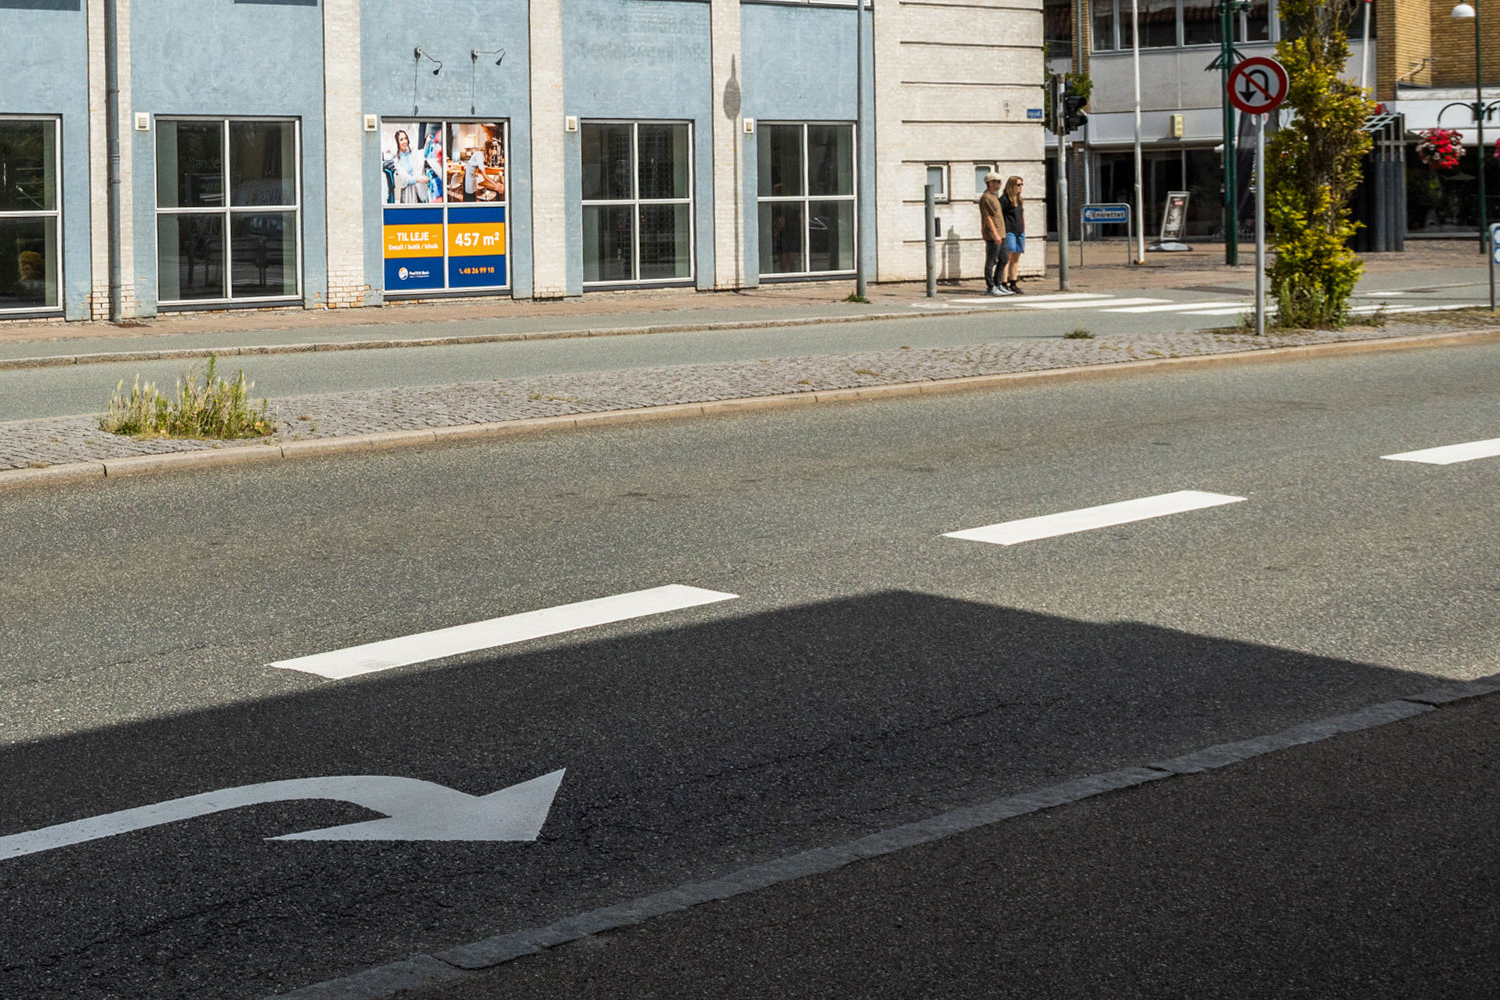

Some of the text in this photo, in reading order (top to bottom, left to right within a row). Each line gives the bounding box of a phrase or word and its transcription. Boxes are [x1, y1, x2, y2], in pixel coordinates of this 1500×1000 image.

[396, 231, 429, 241] TIL LEJE
[455, 232, 480, 246] 457
